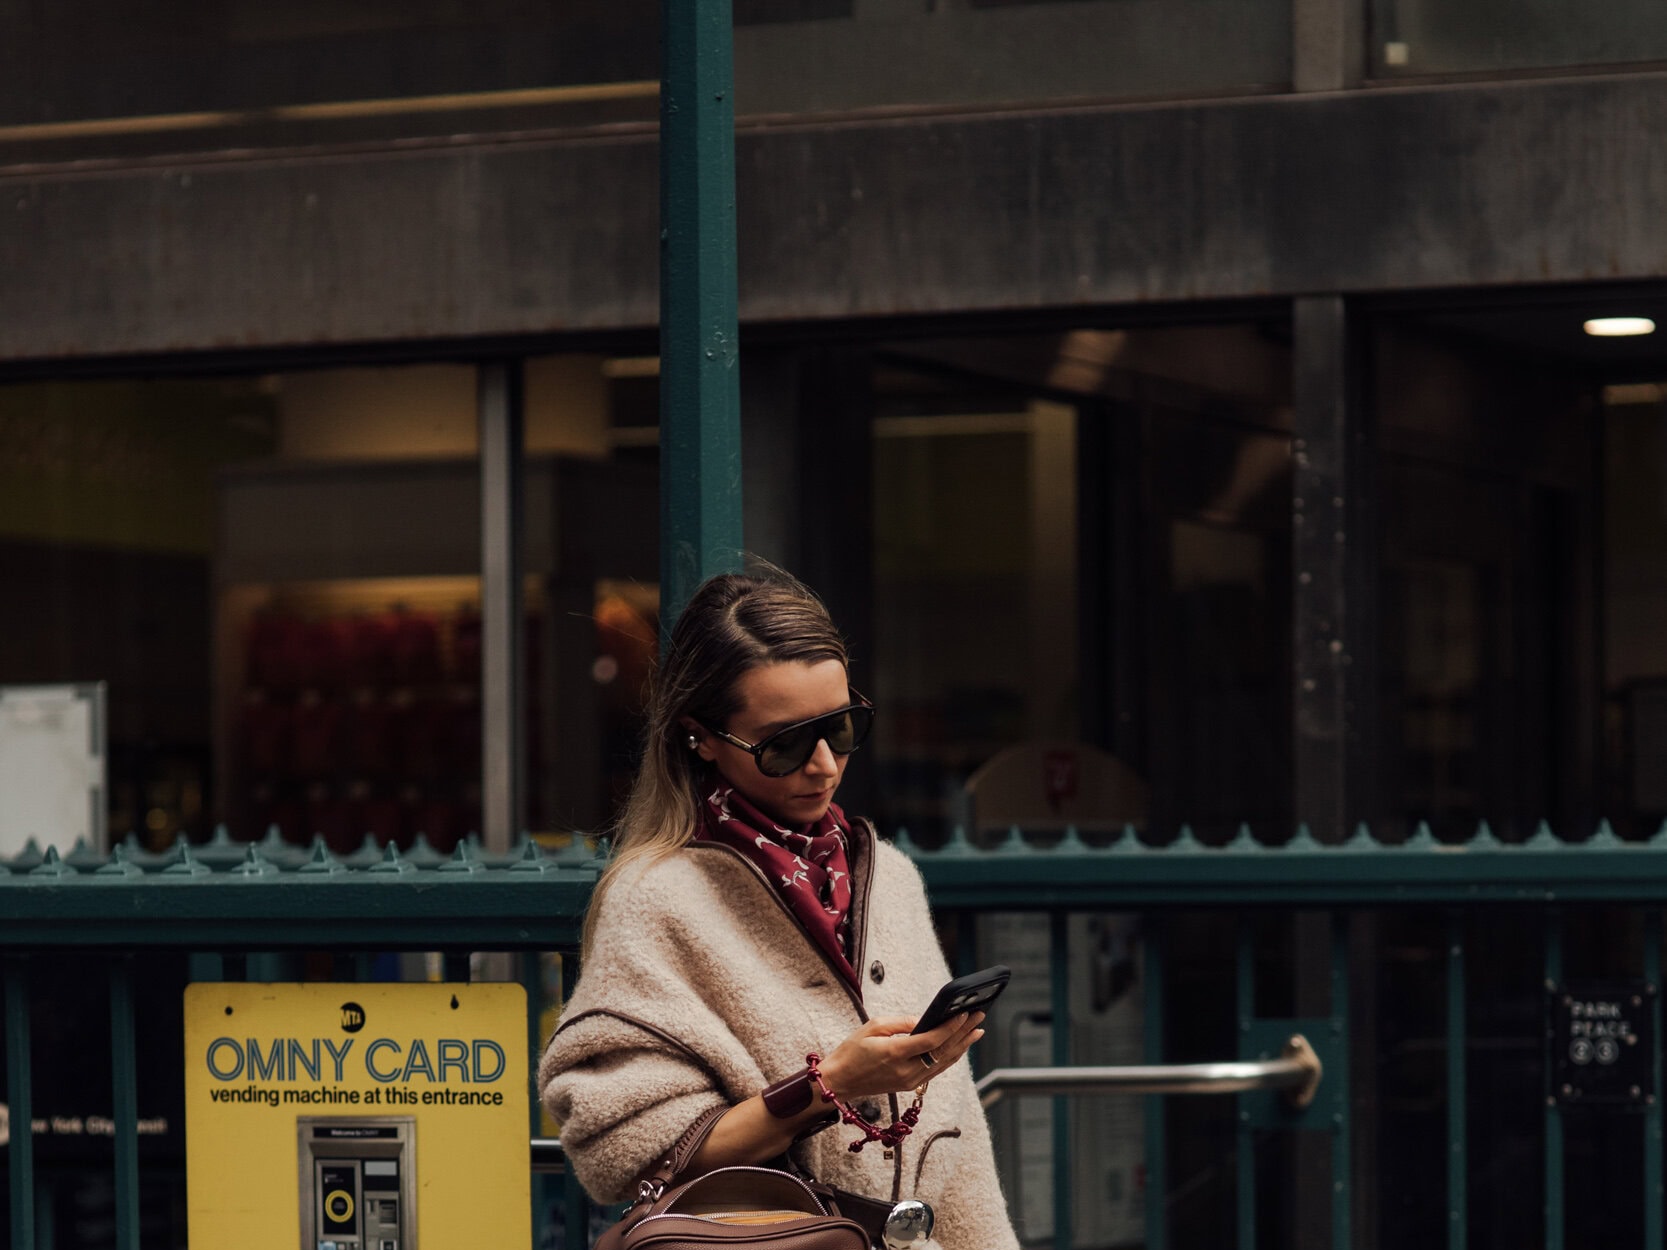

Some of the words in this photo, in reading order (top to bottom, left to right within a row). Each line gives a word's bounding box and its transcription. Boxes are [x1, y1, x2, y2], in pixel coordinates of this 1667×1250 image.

[1571, 1001, 1622, 1018] PARK
[1571, 1020, 1631, 1038] PLACE
[206, 1037, 354, 1082] OMNY
[365, 1038, 506, 1083] CARD
[210, 1085, 280, 1107] vending
[283, 1086, 360, 1104] machine
[364, 1087, 381, 1104] at
[385, 1086, 418, 1104] this
[421, 1088, 503, 1105] entrance
